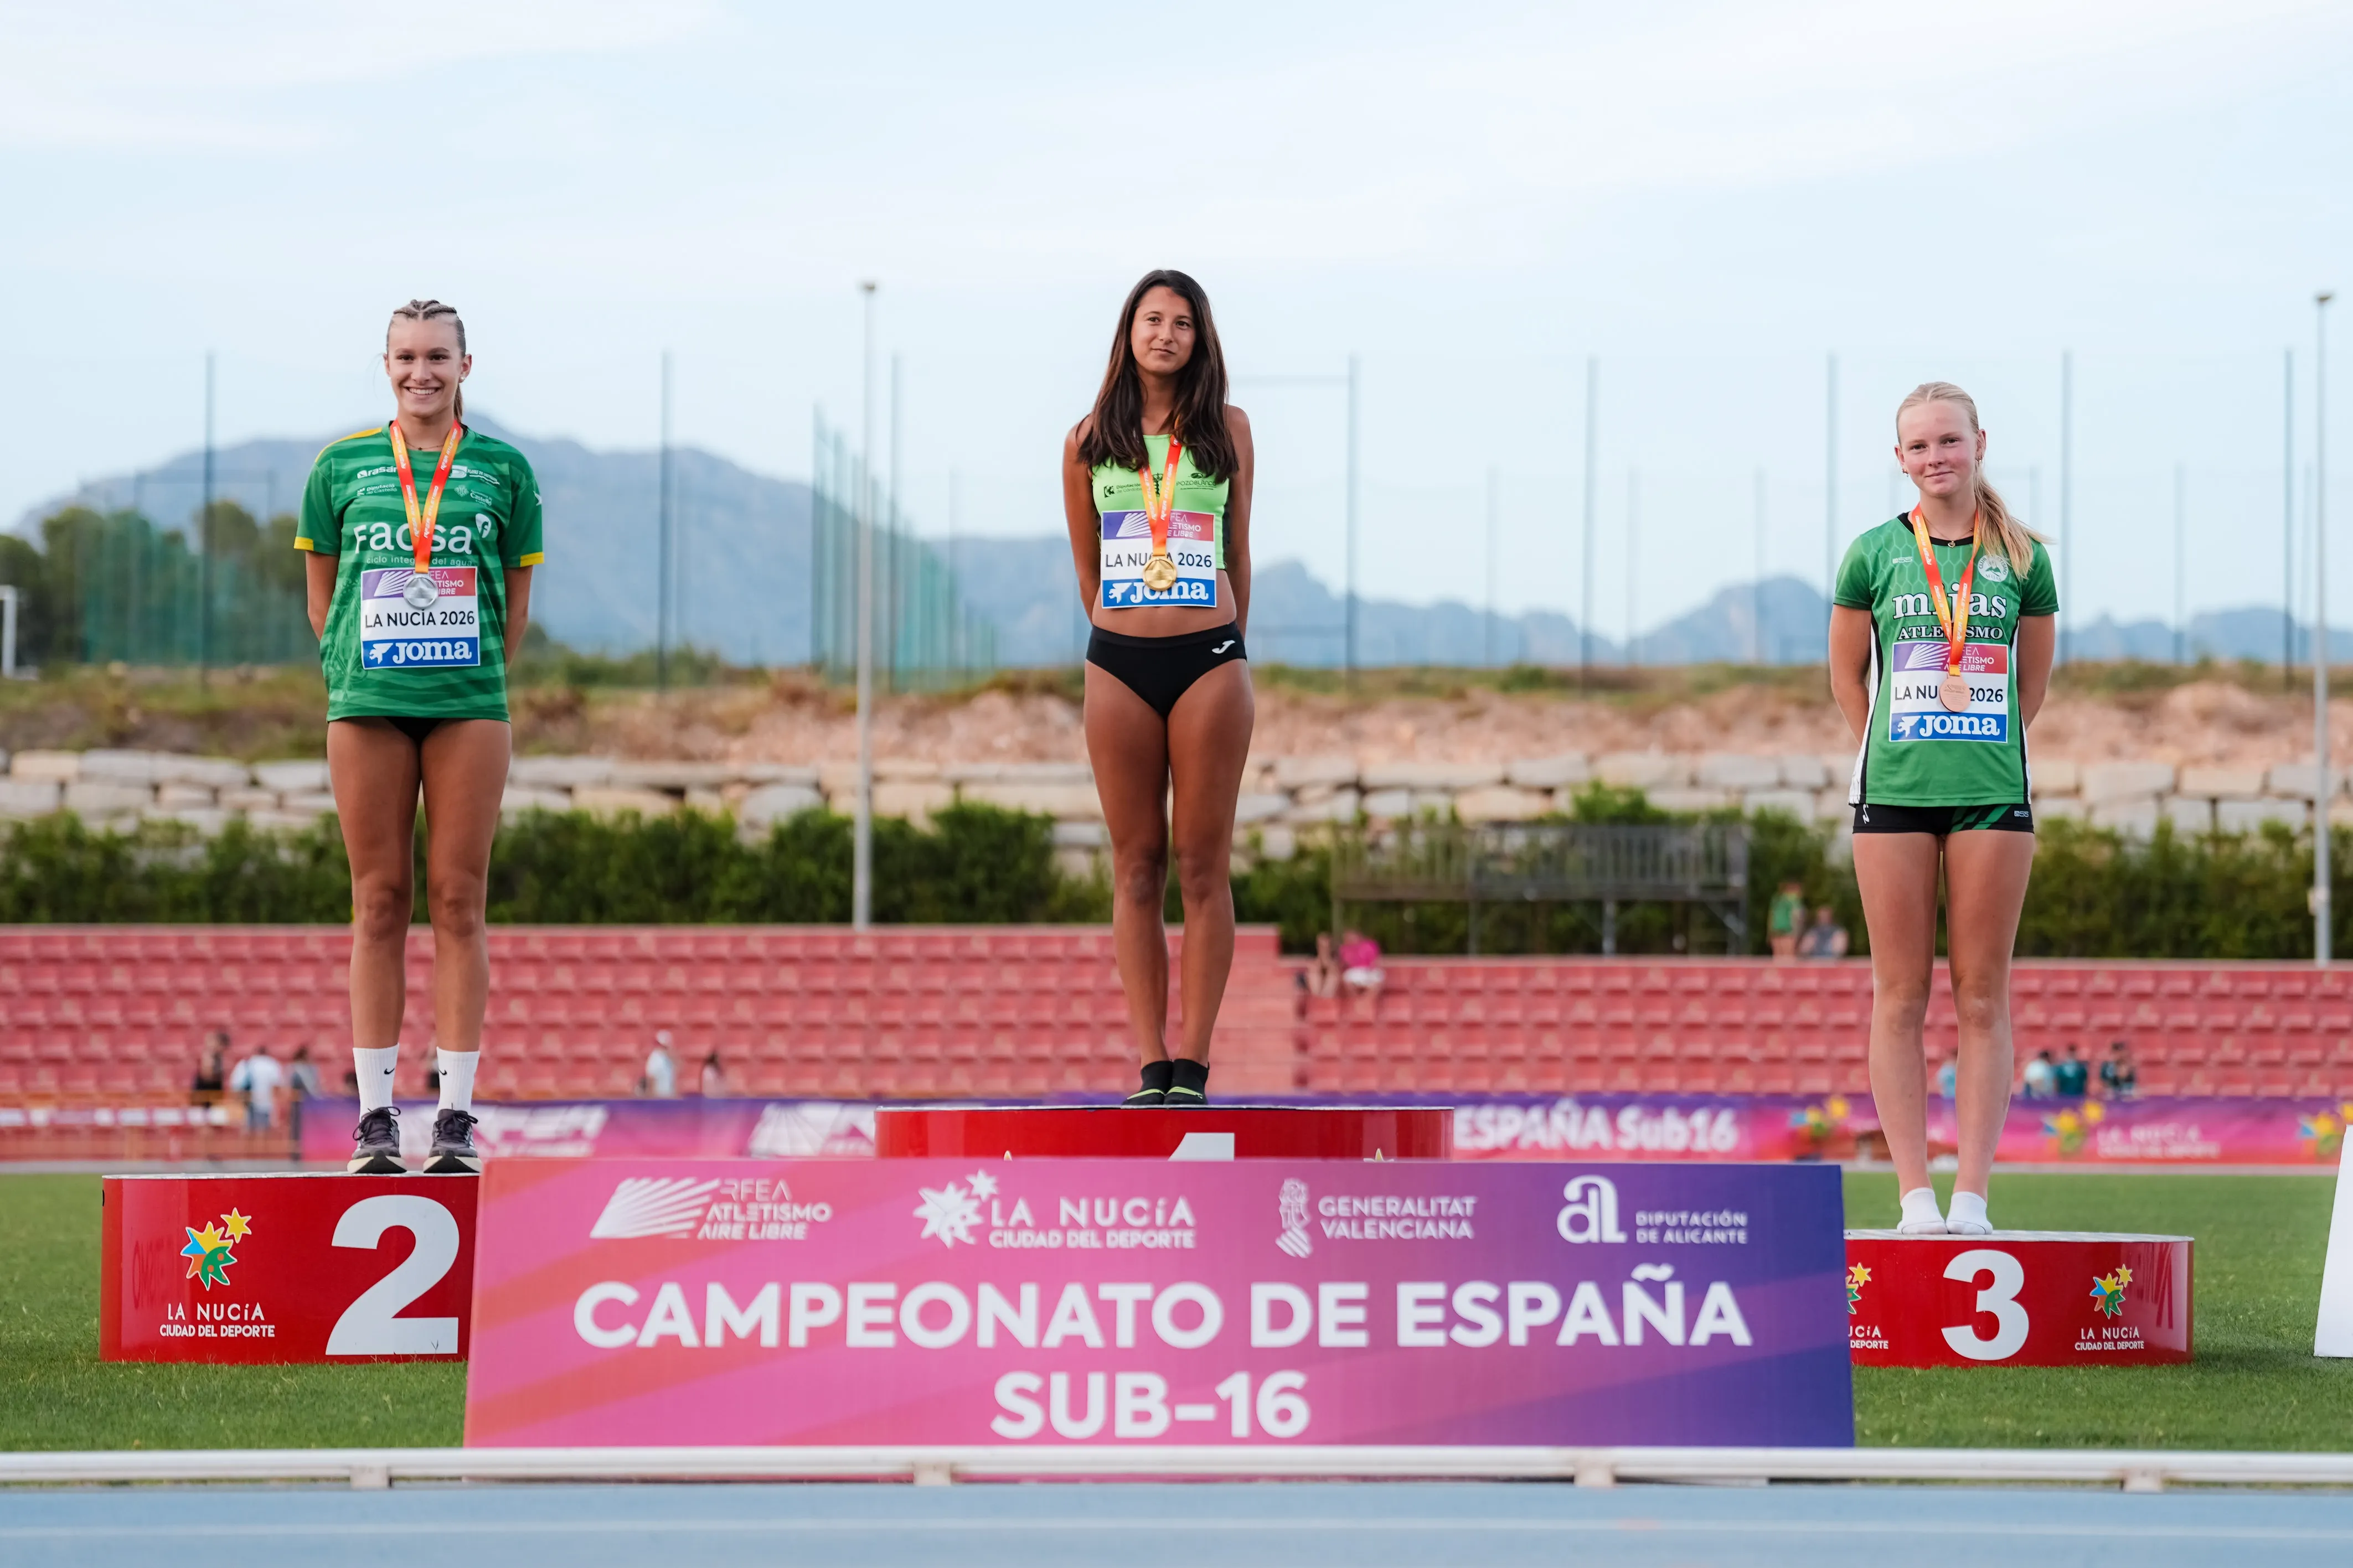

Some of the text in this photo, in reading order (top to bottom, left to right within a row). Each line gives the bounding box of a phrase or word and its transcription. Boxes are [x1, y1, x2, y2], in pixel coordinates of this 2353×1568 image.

[1170, 513, 1188, 522] FEA
[1173, 530, 1194, 538] LIBRE
[367, 556, 387, 564] ciclo
[391, 555, 415, 566] integ
[1105, 553, 1123, 567] LA
[1178, 553, 1212, 568] 2026
[430, 570, 448, 579] FEA
[1892, 583, 2007, 623] mjas
[365, 613, 383, 628] LA
[440, 611, 474, 625] 2026
[1897, 625, 2004, 640] ATLESMO
[1895, 686, 1912, 700] LA
[1970, 687, 2003, 702] 2026
[1453, 1097, 1739, 1152] ESPAÑA Sub16
[720, 1178, 792, 1202] RFEA
[705, 1202, 833, 1223] ATLETISMO
[991, 1196, 1034, 1228] LA
[1318, 1196, 1478, 1217] GENERALITAT
[1635, 1208, 1748, 1227] DIPUTACIÓN
[698, 1222, 808, 1240] AIRE LIBRE
[1319, 1218, 1475, 1240] VALENCIANA
[1635, 1228, 1748, 1244] DE ALICANTE
[989, 1229, 1197, 1249] CIUDAD DEL DEPORTE
[325, 1194, 460, 1355] 2
[168, 1302, 185, 1321] LA
[572, 1261, 1753, 1349] CAMPEONATO DE ESPAÑA
[1941, 1249, 2030, 1360] 3
[159, 1324, 275, 1337] CIUDAD DEL DEPORTE
[2081, 1327, 2095, 1340] LA
[1850, 1340, 1888, 1349] DEPORTE
[2075, 1341, 2144, 1350] CIUDAD DEL DEPORTE
